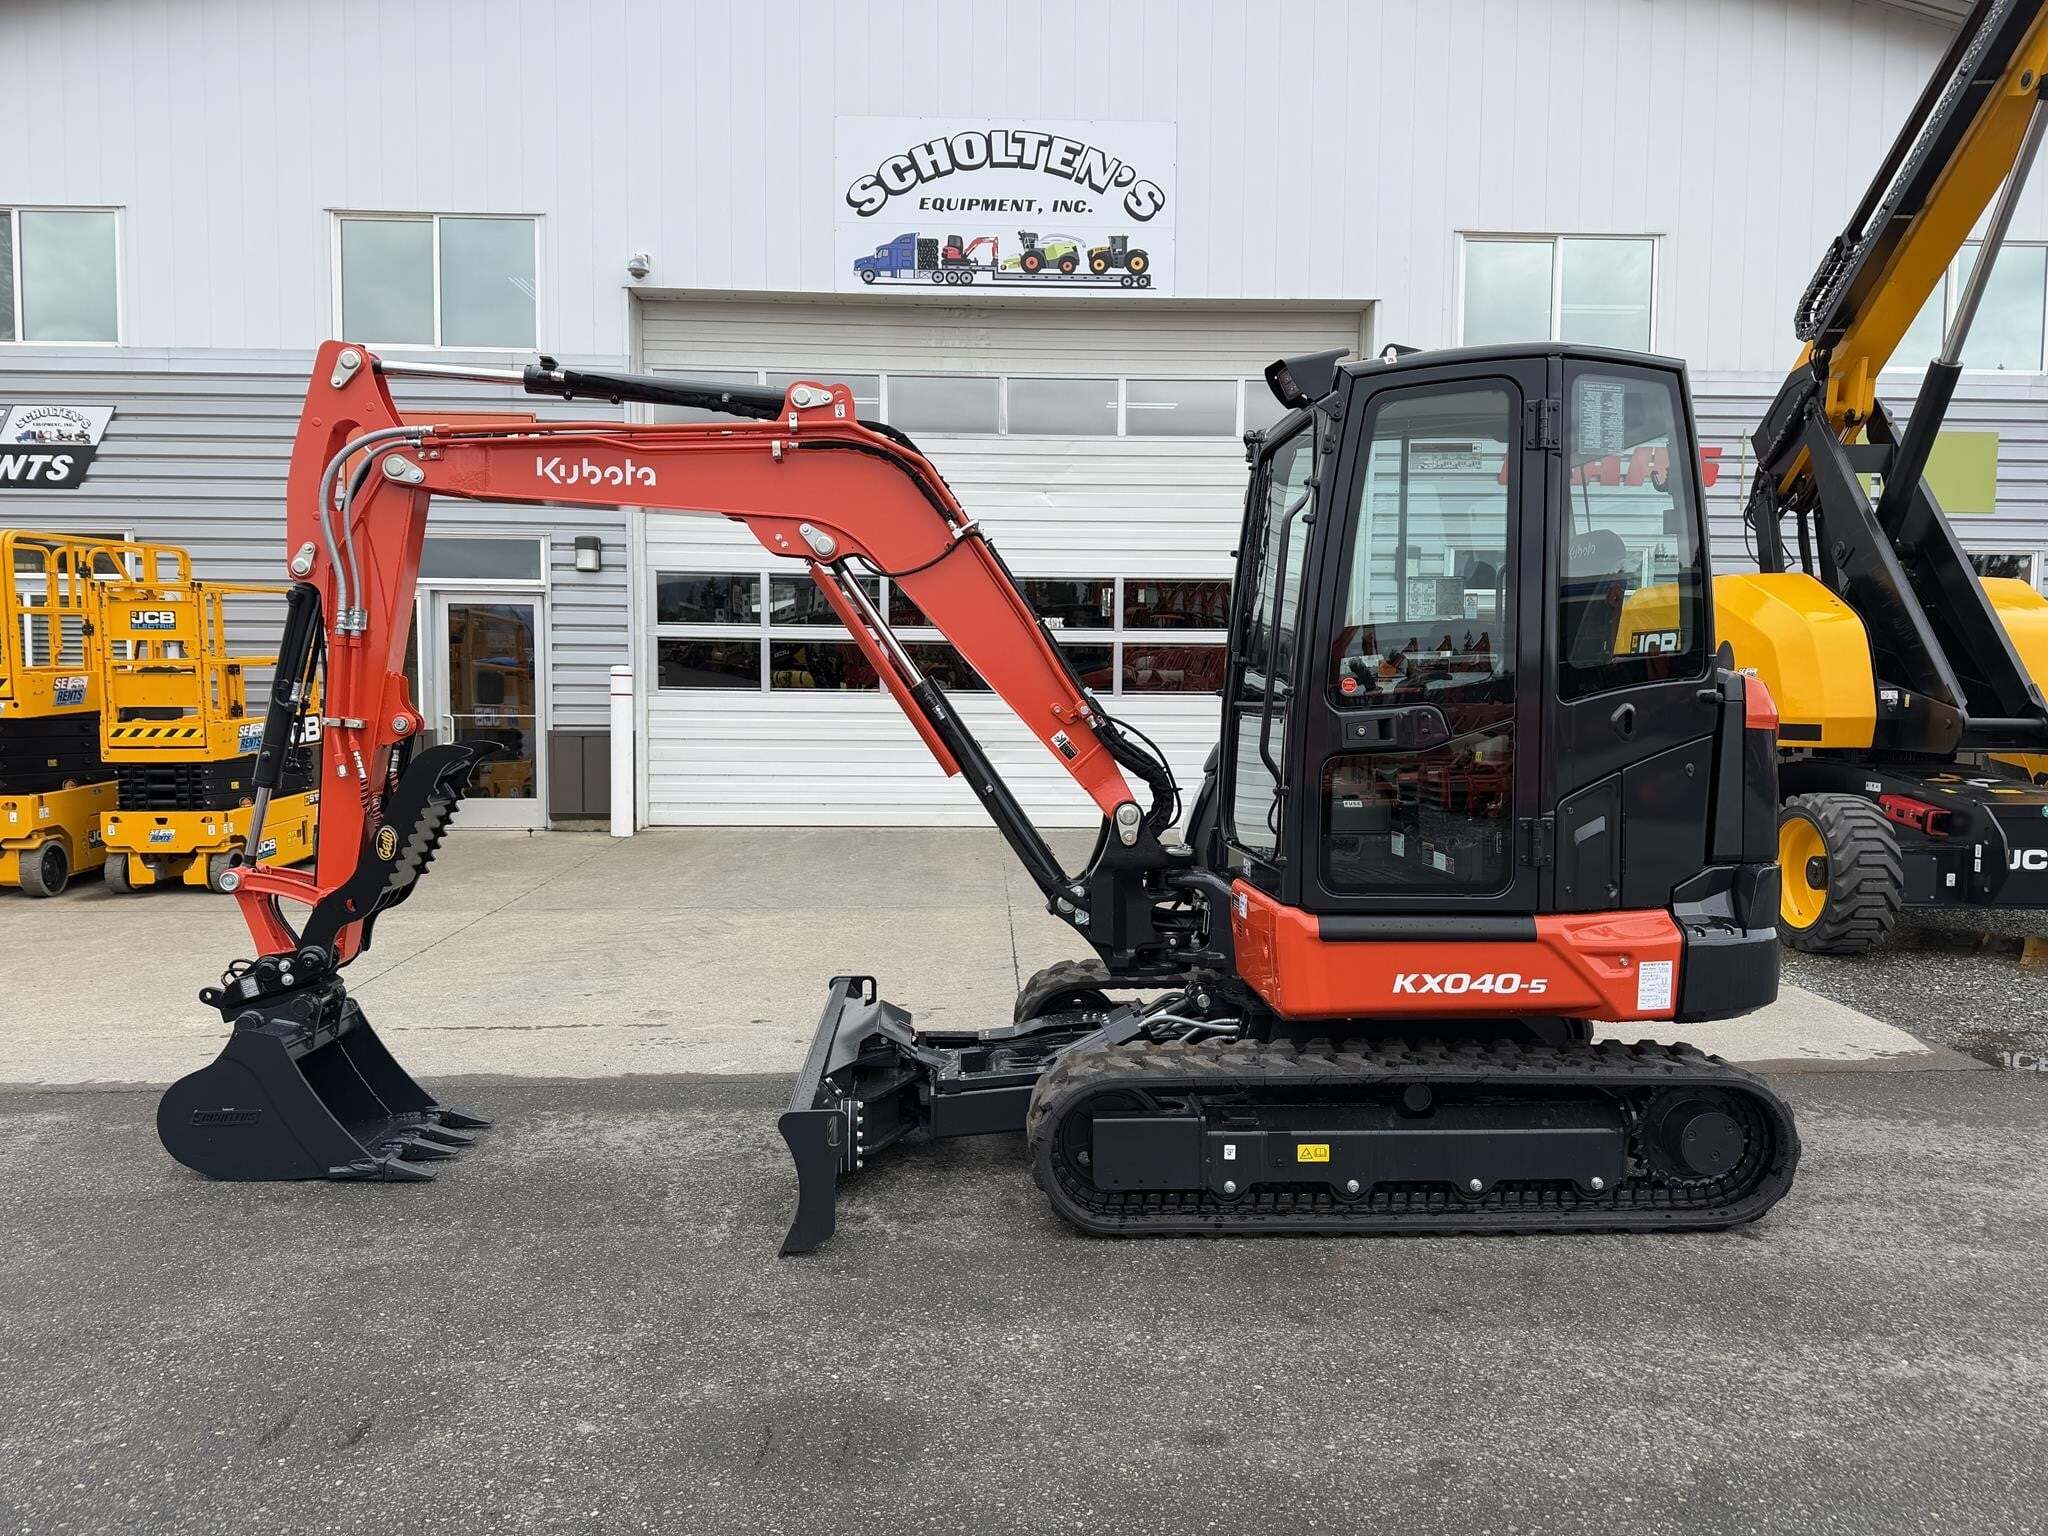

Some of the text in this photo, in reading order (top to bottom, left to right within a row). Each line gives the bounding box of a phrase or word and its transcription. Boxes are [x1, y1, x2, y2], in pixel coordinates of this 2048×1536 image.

[846, 130, 1165, 222] SCHOLTEN'S
[919, 197, 1093, 215] EQUIPMENT, INC.
[0, 454, 74, 481] NTS
[536, 457, 657, 486] Kubota
[131, 611, 175, 624] JCB
[57, 690, 82, 703] RENTS
[1393, 973, 1548, 994] KX040-5
